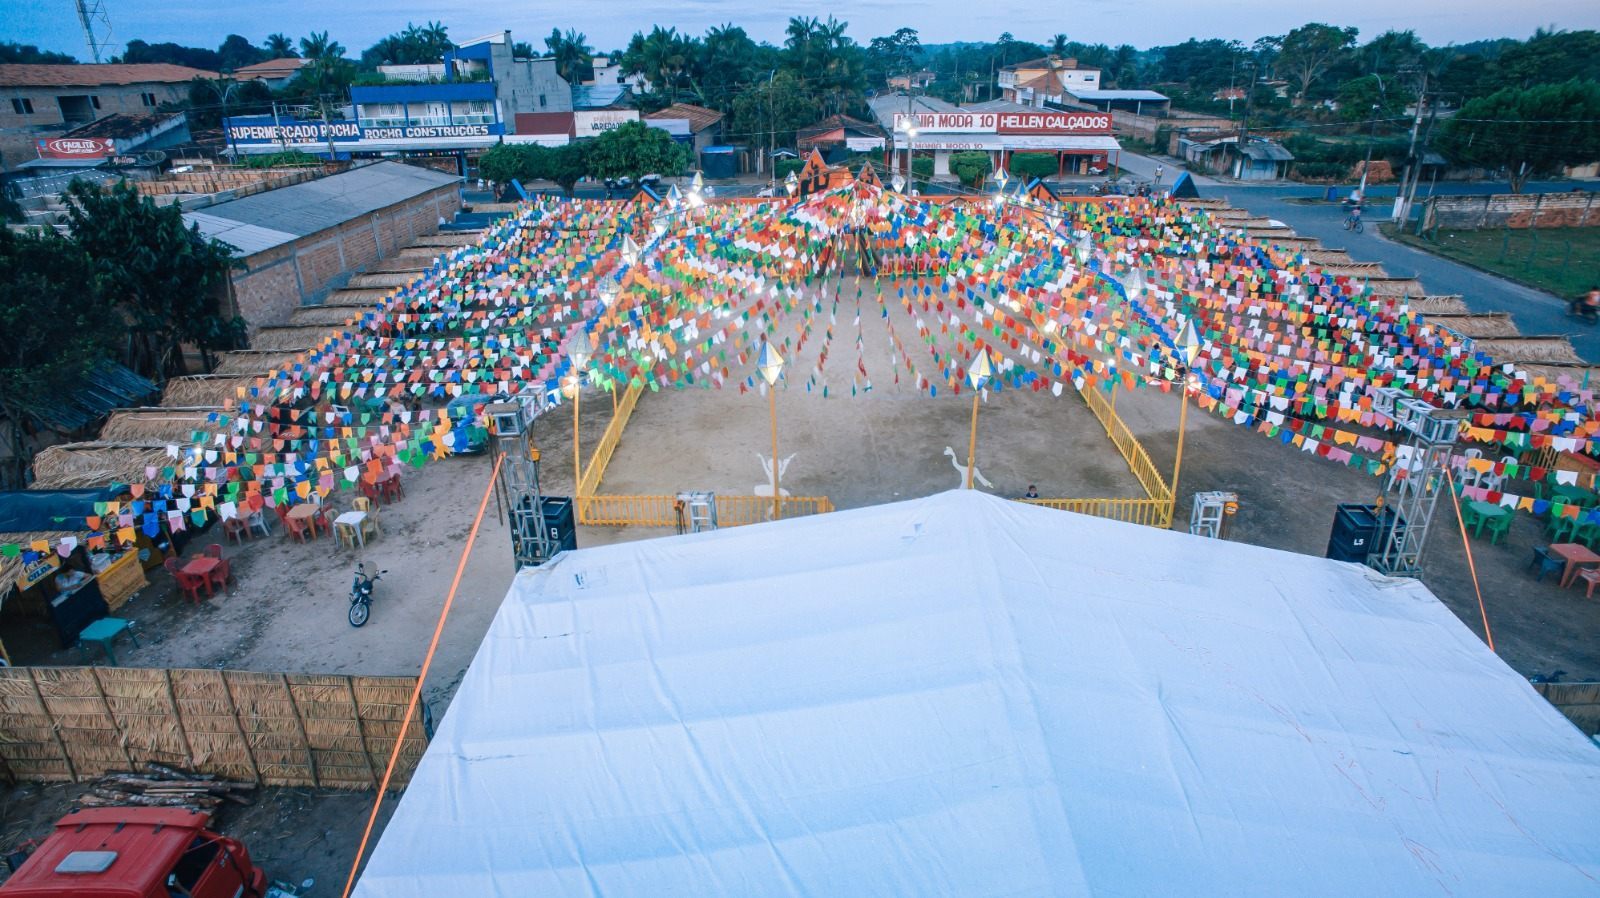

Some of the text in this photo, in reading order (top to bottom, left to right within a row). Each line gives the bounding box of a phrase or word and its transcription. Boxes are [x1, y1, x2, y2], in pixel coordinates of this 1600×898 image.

[939, 114, 973, 128] MODA
[980, 114, 994, 128] 10
[1000, 116, 1109, 130] HELLEN CALÇADOS
[228, 123, 360, 139] SUPERMERCADO ROCHA
[364, 125, 489, 139] ROCHA CONSTRUÇÕES
